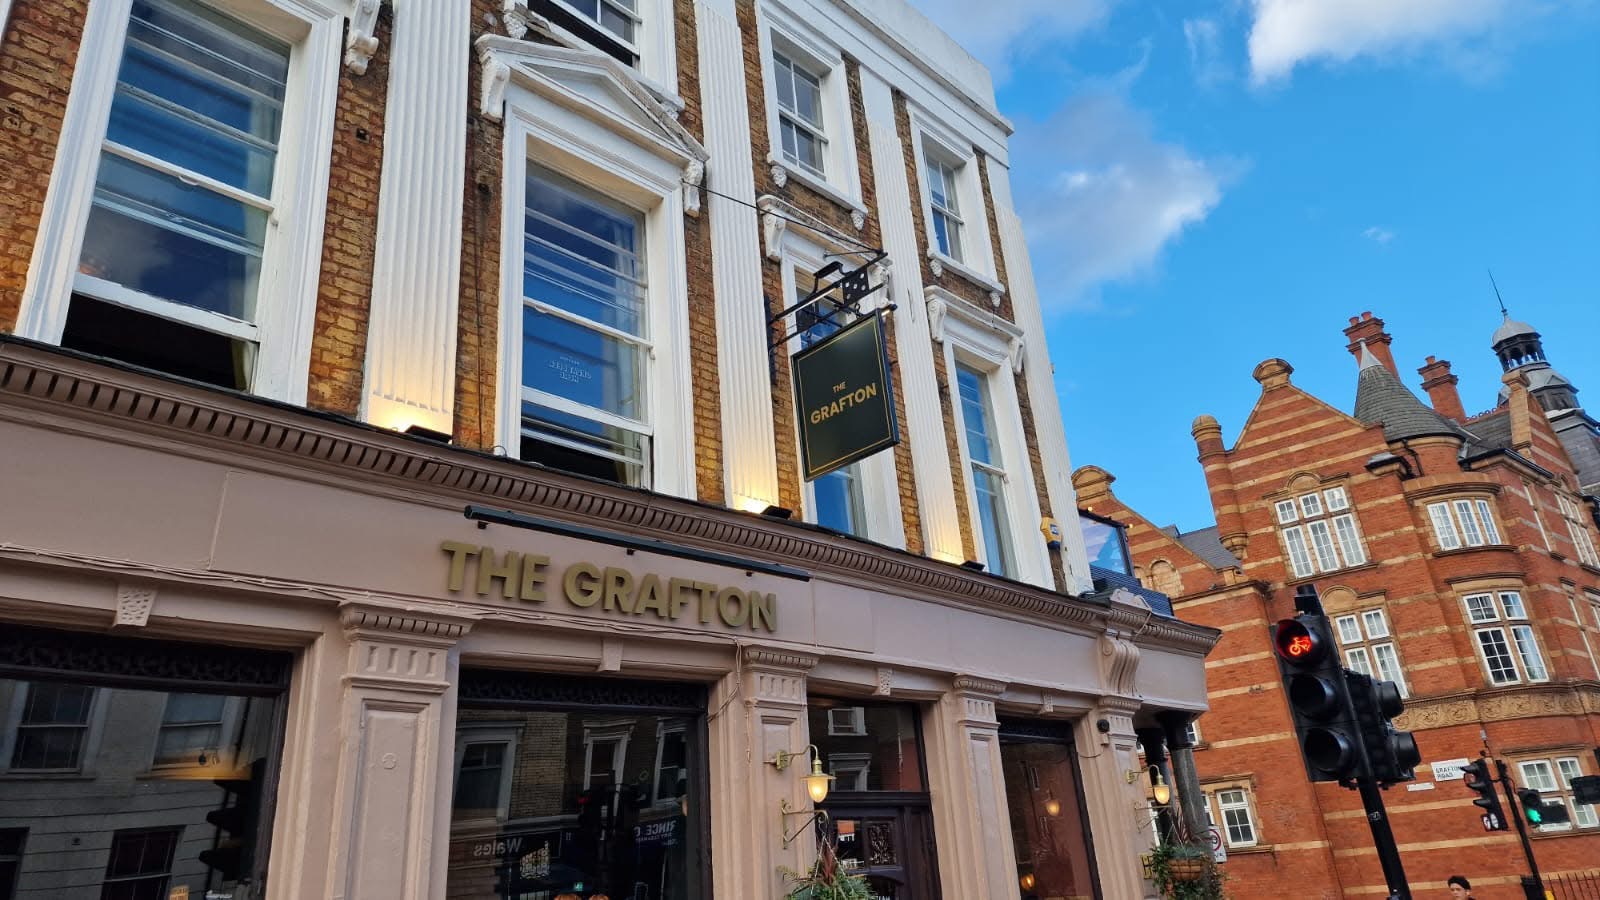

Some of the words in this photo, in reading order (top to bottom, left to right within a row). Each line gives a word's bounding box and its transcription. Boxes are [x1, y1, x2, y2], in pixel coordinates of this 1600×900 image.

[810, 382, 878, 424] GRAFTON
[832, 382, 846, 393] THE
[440, 540, 550, 602] THE
[563, 562, 778, 633] GRAFTON
